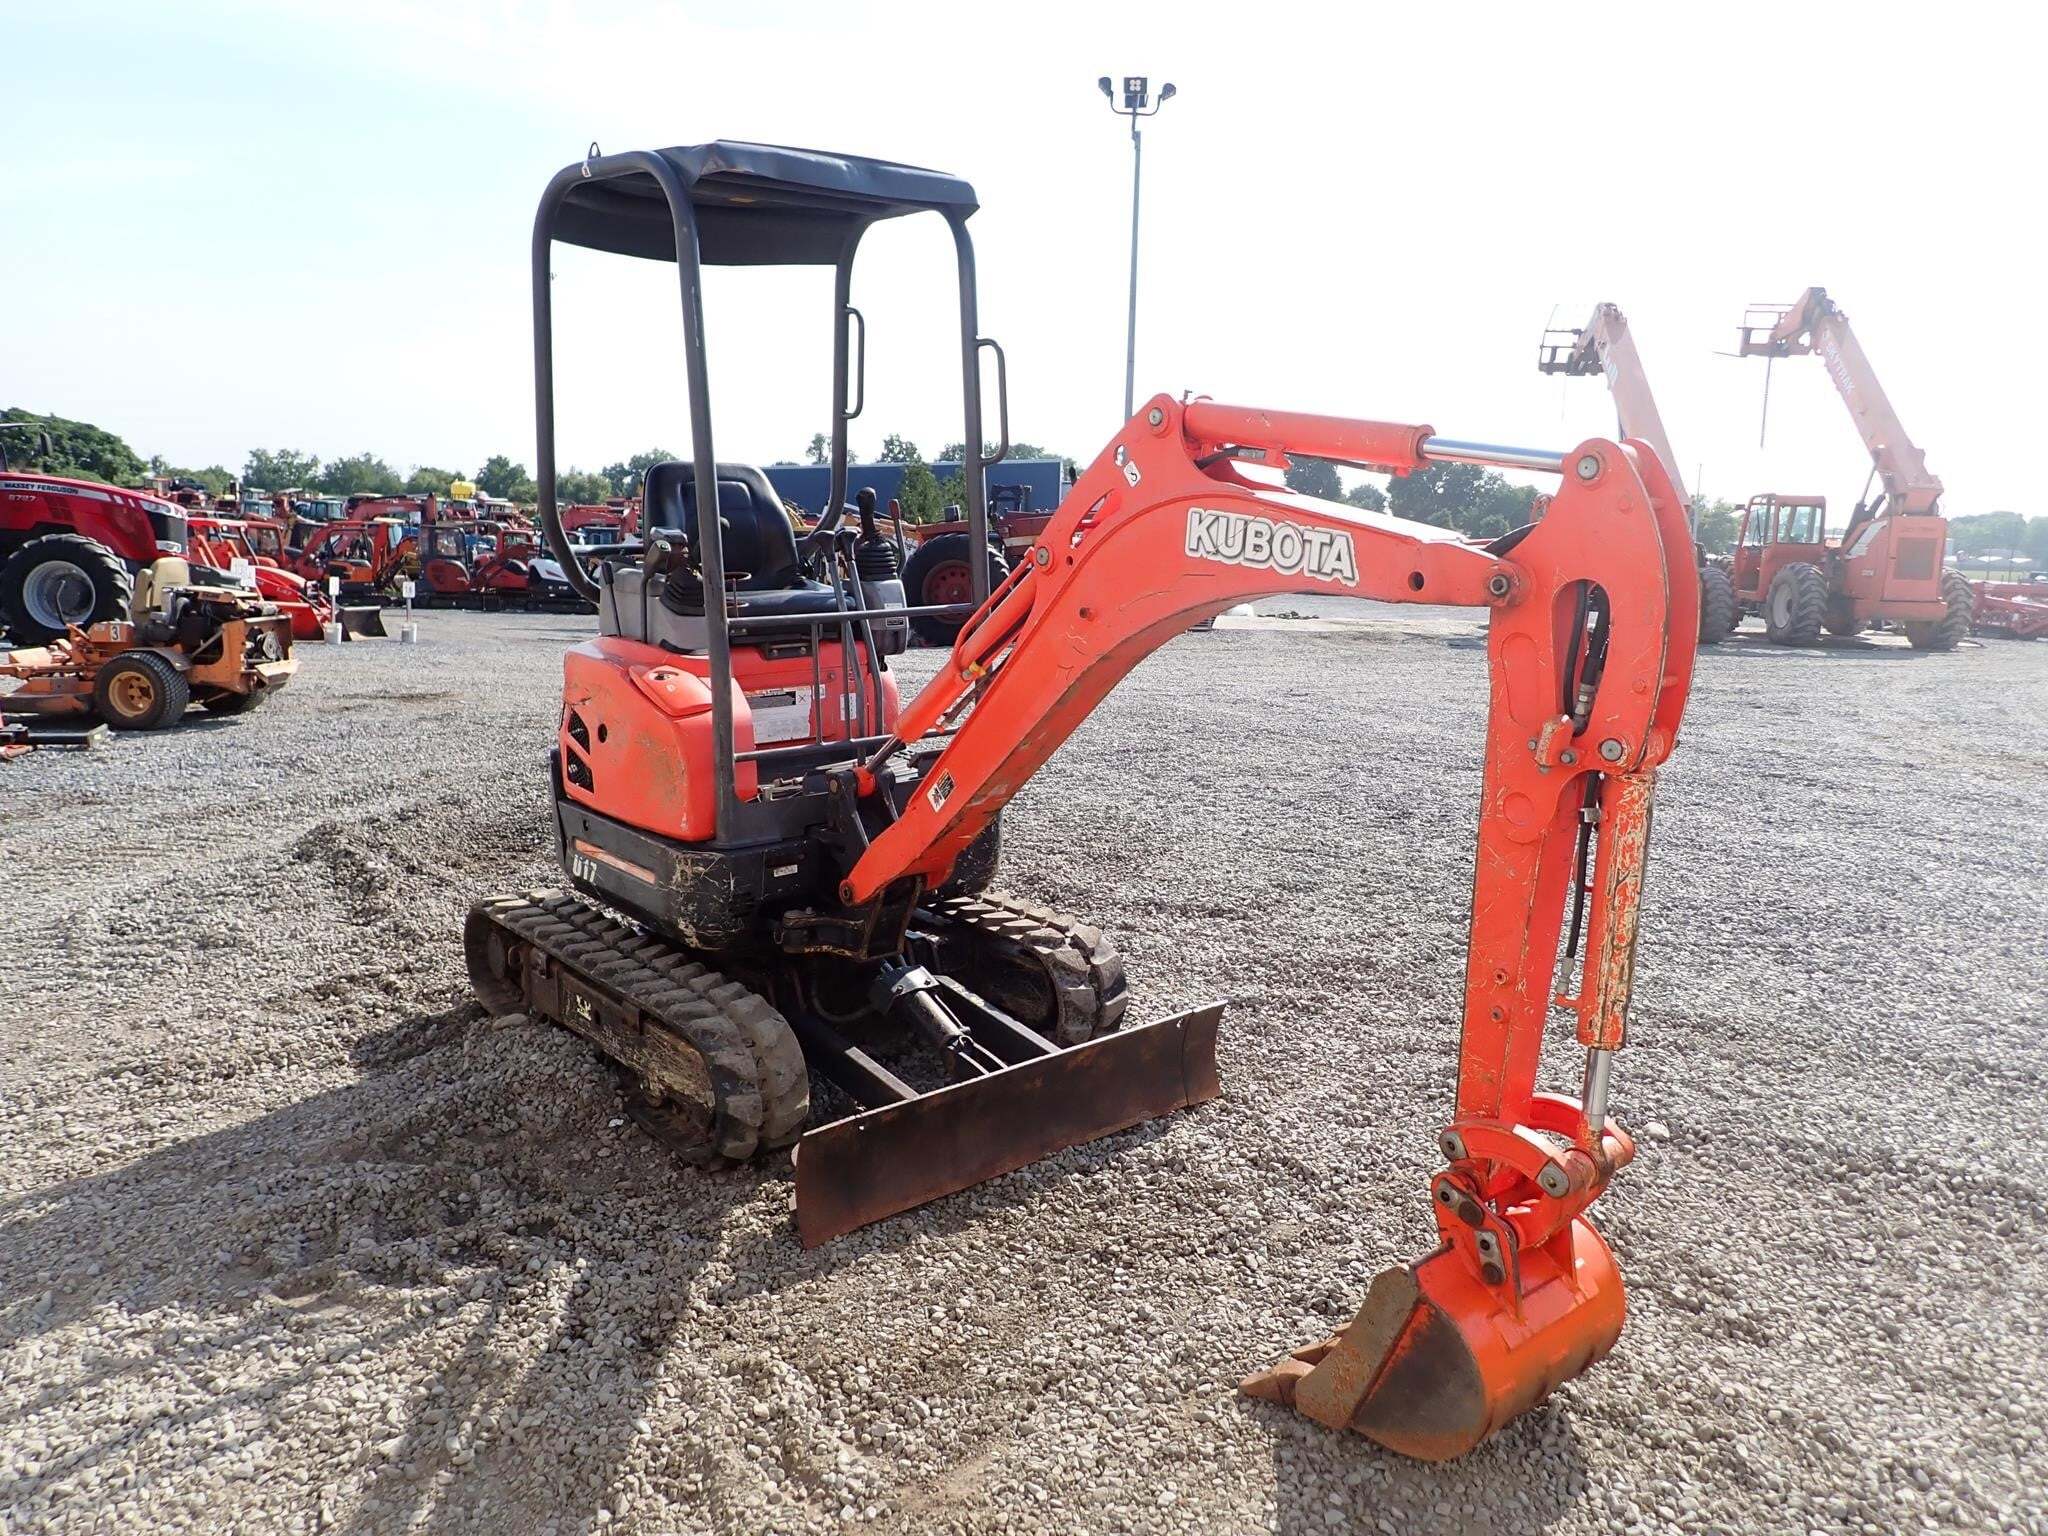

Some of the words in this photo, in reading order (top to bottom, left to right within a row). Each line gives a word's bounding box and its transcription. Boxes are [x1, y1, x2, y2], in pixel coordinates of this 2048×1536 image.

[37, 484, 79, 494] FERGUSON
[1188, 511, 1355, 580] KUBOTA
[112, 626, 119, 640] 3
